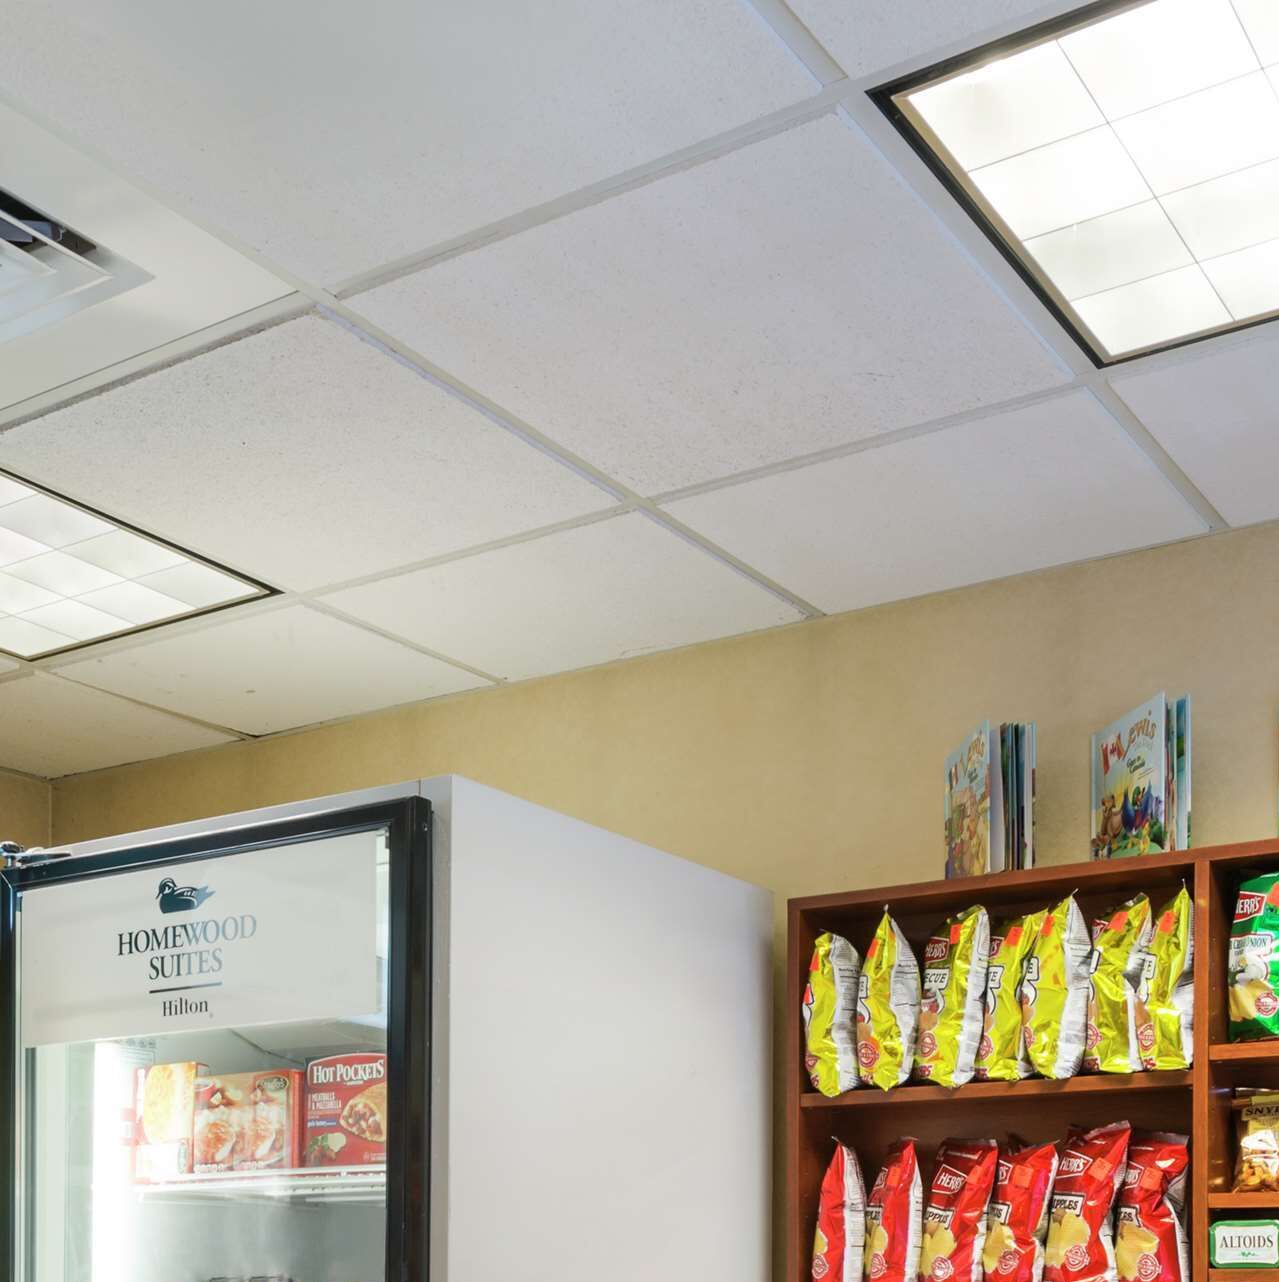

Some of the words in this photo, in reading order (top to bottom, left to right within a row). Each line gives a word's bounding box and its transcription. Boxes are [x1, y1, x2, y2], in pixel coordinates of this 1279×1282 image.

[117, 914, 257, 956] HOMEWOOD
[148, 948, 223, 980] SUITES
[162, 998, 209, 1017] Hilton
[336, 1060, 384, 1081] POCKETS
[1220, 1234, 1274, 1249] ALTOIDS
